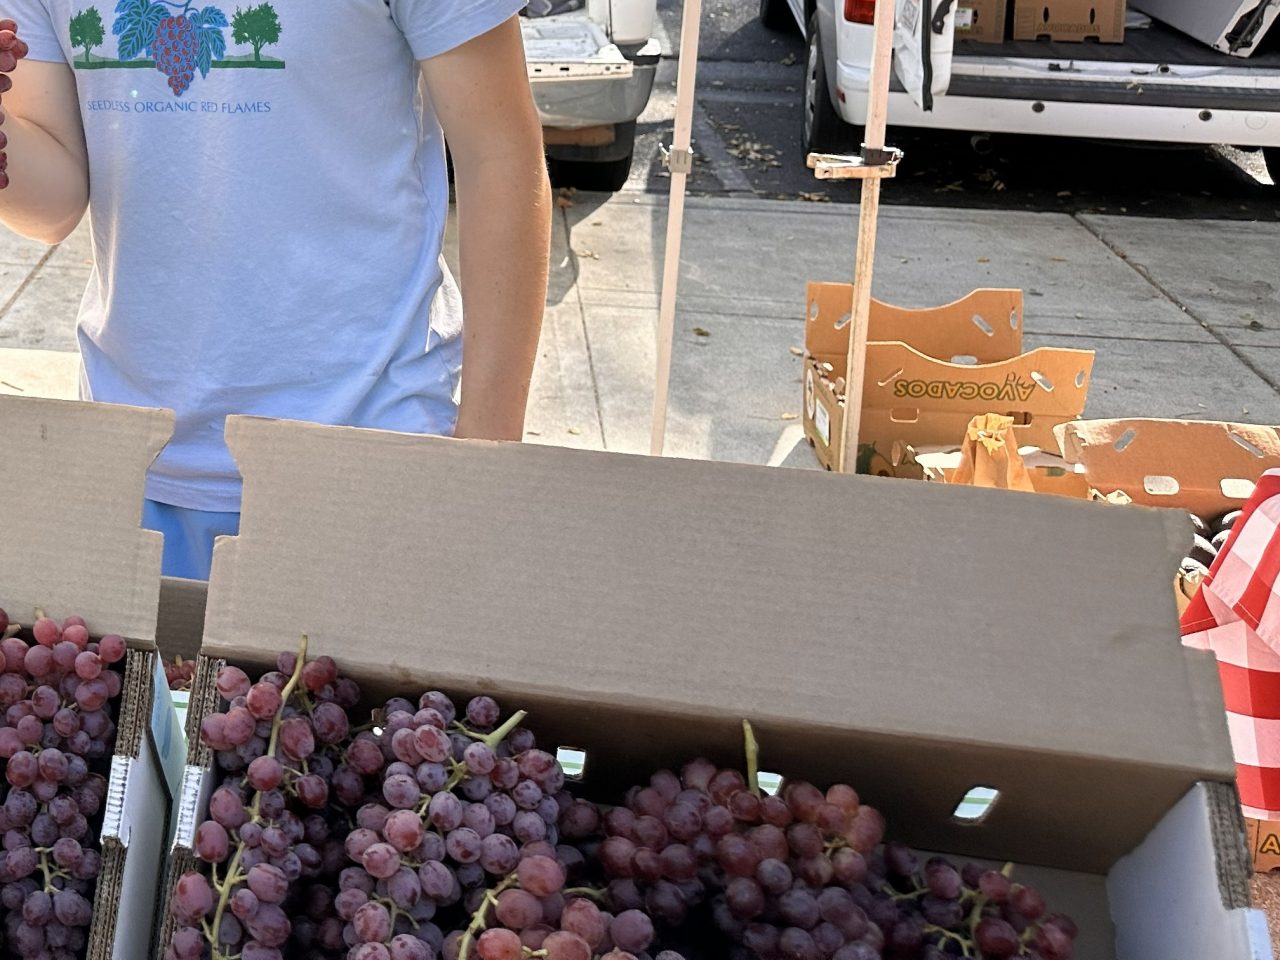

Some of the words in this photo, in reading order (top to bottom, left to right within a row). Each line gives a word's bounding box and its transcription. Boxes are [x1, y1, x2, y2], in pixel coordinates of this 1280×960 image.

[87, 100, 130, 112] SEEDLESS
[134, 100, 198, 113] ORGANIC
[201, 100, 218, 113] RED
[221, 100, 272, 114] FLAMES
[894, 379, 1036, 402] AVOCADOS
